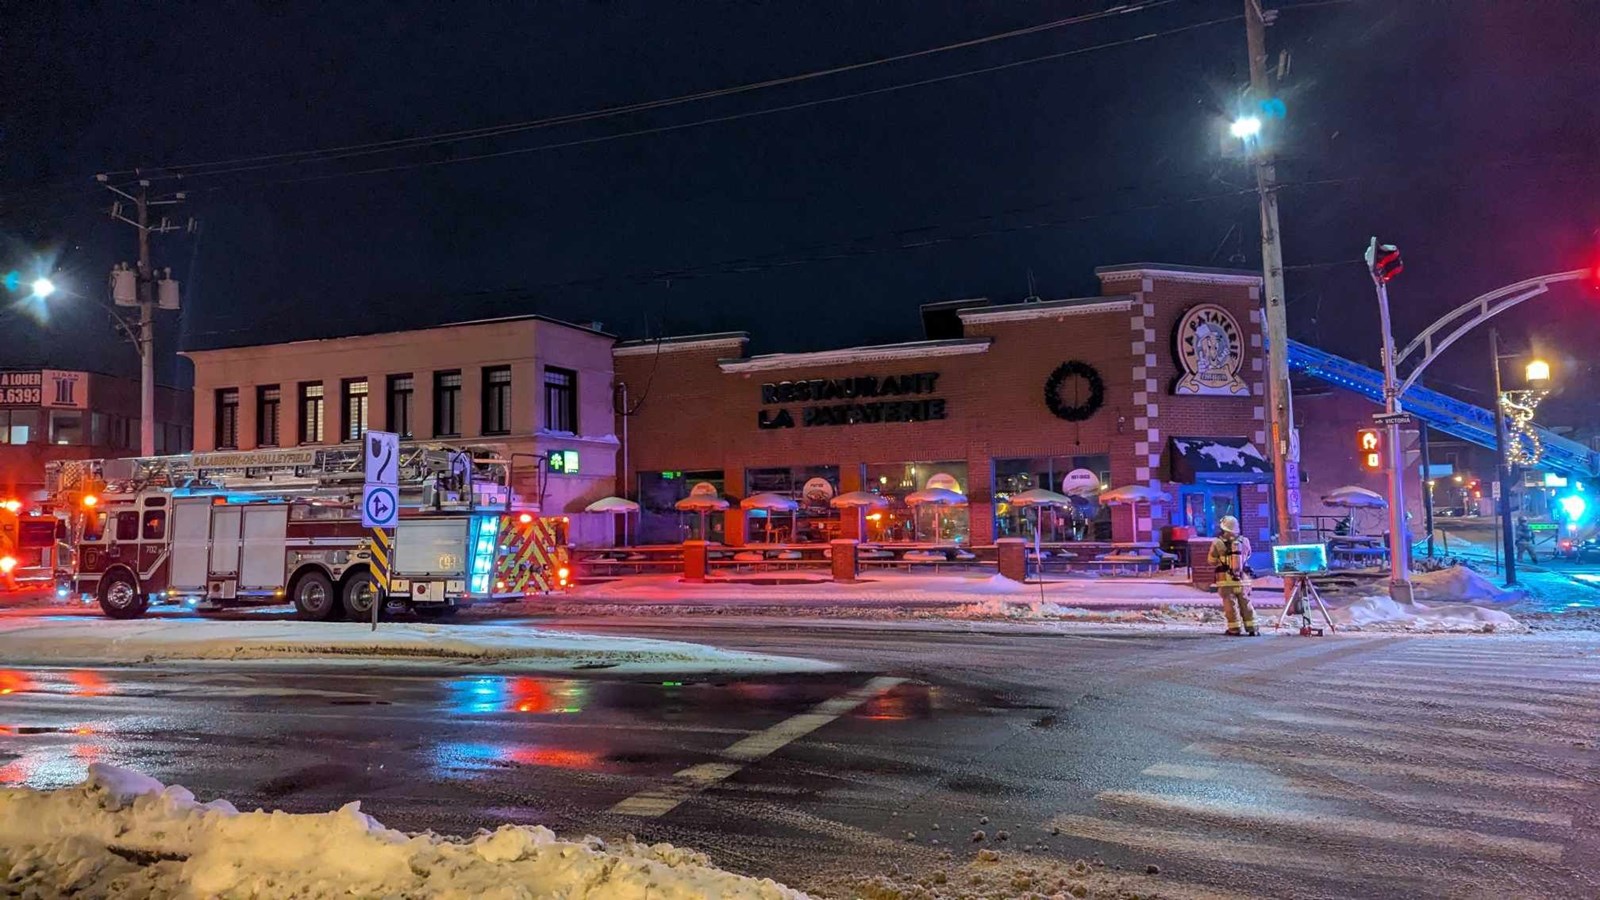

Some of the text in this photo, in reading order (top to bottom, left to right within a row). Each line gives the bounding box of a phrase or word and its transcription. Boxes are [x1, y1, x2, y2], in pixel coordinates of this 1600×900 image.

[10, 373, 41, 385] LOUER
[762, 373, 939, 403] RESTAURANT
[759, 399, 946, 428] LA PATATERIE
